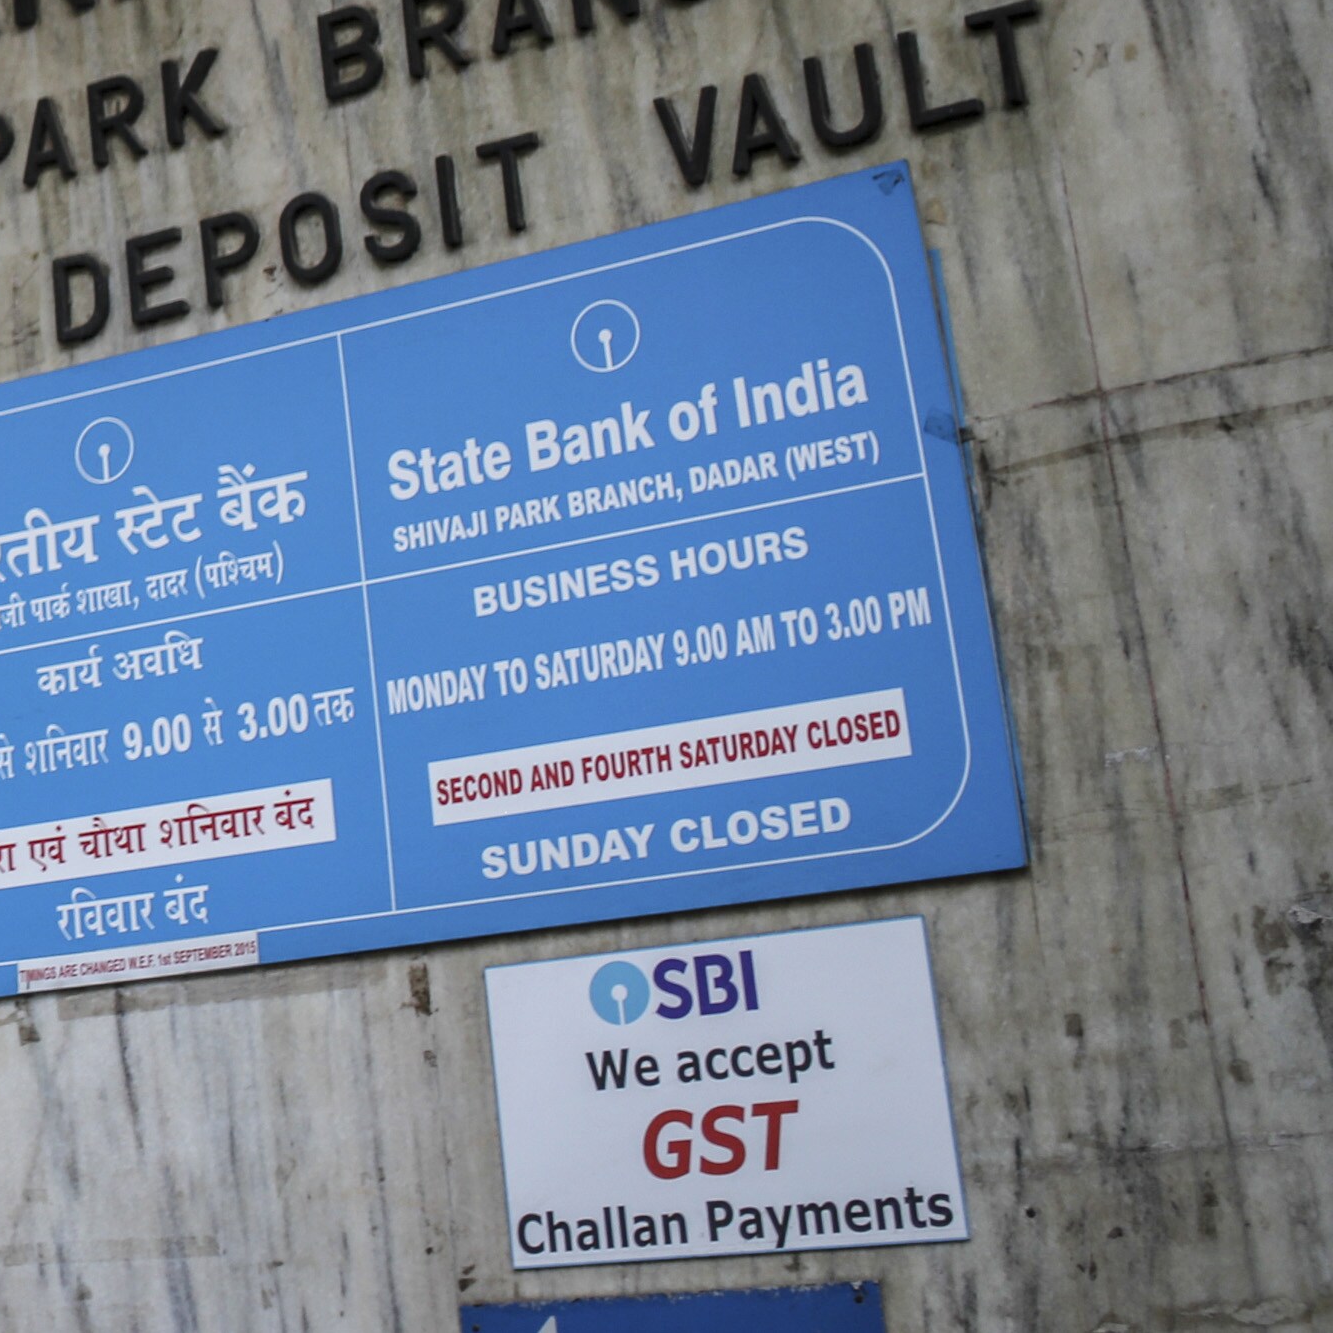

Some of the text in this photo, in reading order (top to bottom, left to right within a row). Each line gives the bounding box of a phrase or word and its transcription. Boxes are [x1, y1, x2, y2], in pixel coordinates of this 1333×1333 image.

[52, 132, 540, 346] DEPOSIT
[387, 358, 868, 501] State Bank of India
[115, 485, 203, 556] स्टेट
[217, 463, 308, 532] बैंक
[393, 431, 880, 552] SHIVAJI PARK BRANCH, DADAR (WEST)
[30, 582, 71, 624] पार्क
[145, 569, 188, 601] दादर
[473, 526, 809, 617] BUSINESS HOURS
[37, 630, 203, 697] कार्य अवधि
[386, 587, 932, 715] MONDAY TO SATURDAY 9.00 AM TO 3.00 PM
[24, 724, 110, 775] शनिवार
[122, 714, 192, 761] 9.00
[202, 697, 224, 746] से
[237, 693, 309, 742] 3.00
[313, 687, 355, 727] तक
[436, 709, 901, 806] SECOND AND FOURTH SATURDAY CLOSED
[28, 825, 66, 871] एवं
[78, 817, 146, 859] चौथा
[160, 803, 265, 849] शनिवार
[274, 789, 315, 830] बंद
[481, 797, 852, 880] SUNDAY CLOSED
[56, 874, 209, 941] रविवार बंद
[59, 963, 78, 977] ARE
[80, 960, 126, 976] CHANGED
[157, 952, 172, 965] 1st
[173, 943, 233, 964] SEPTEMBER
[653, 950, 759, 1020] SBI
[585, 1029, 836, 1091] We accept
[643, 1099, 799, 1181] GST
[517, 1187, 954, 1255] Challan Payments
